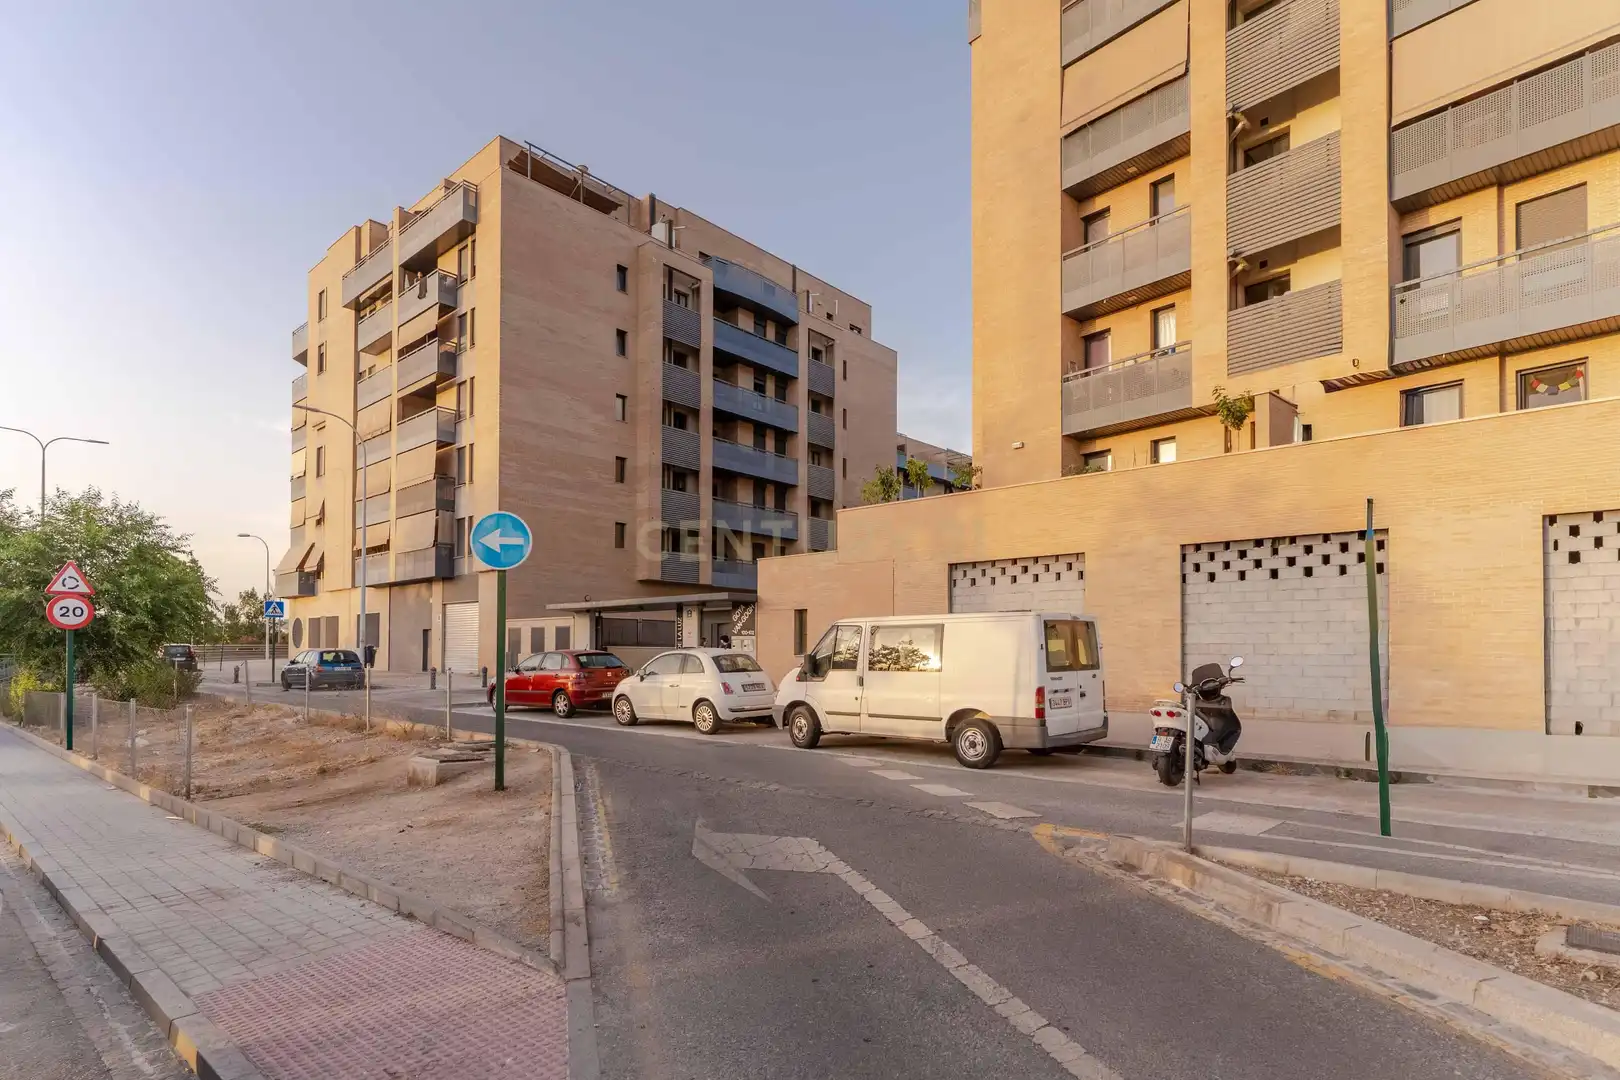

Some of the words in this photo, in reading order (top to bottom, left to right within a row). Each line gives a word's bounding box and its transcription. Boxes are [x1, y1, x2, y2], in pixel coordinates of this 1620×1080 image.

[59, 606, 84, 618] 20
[732, 604, 746, 622] GOYA
[732, 604, 755, 634] VAN-GOGH
